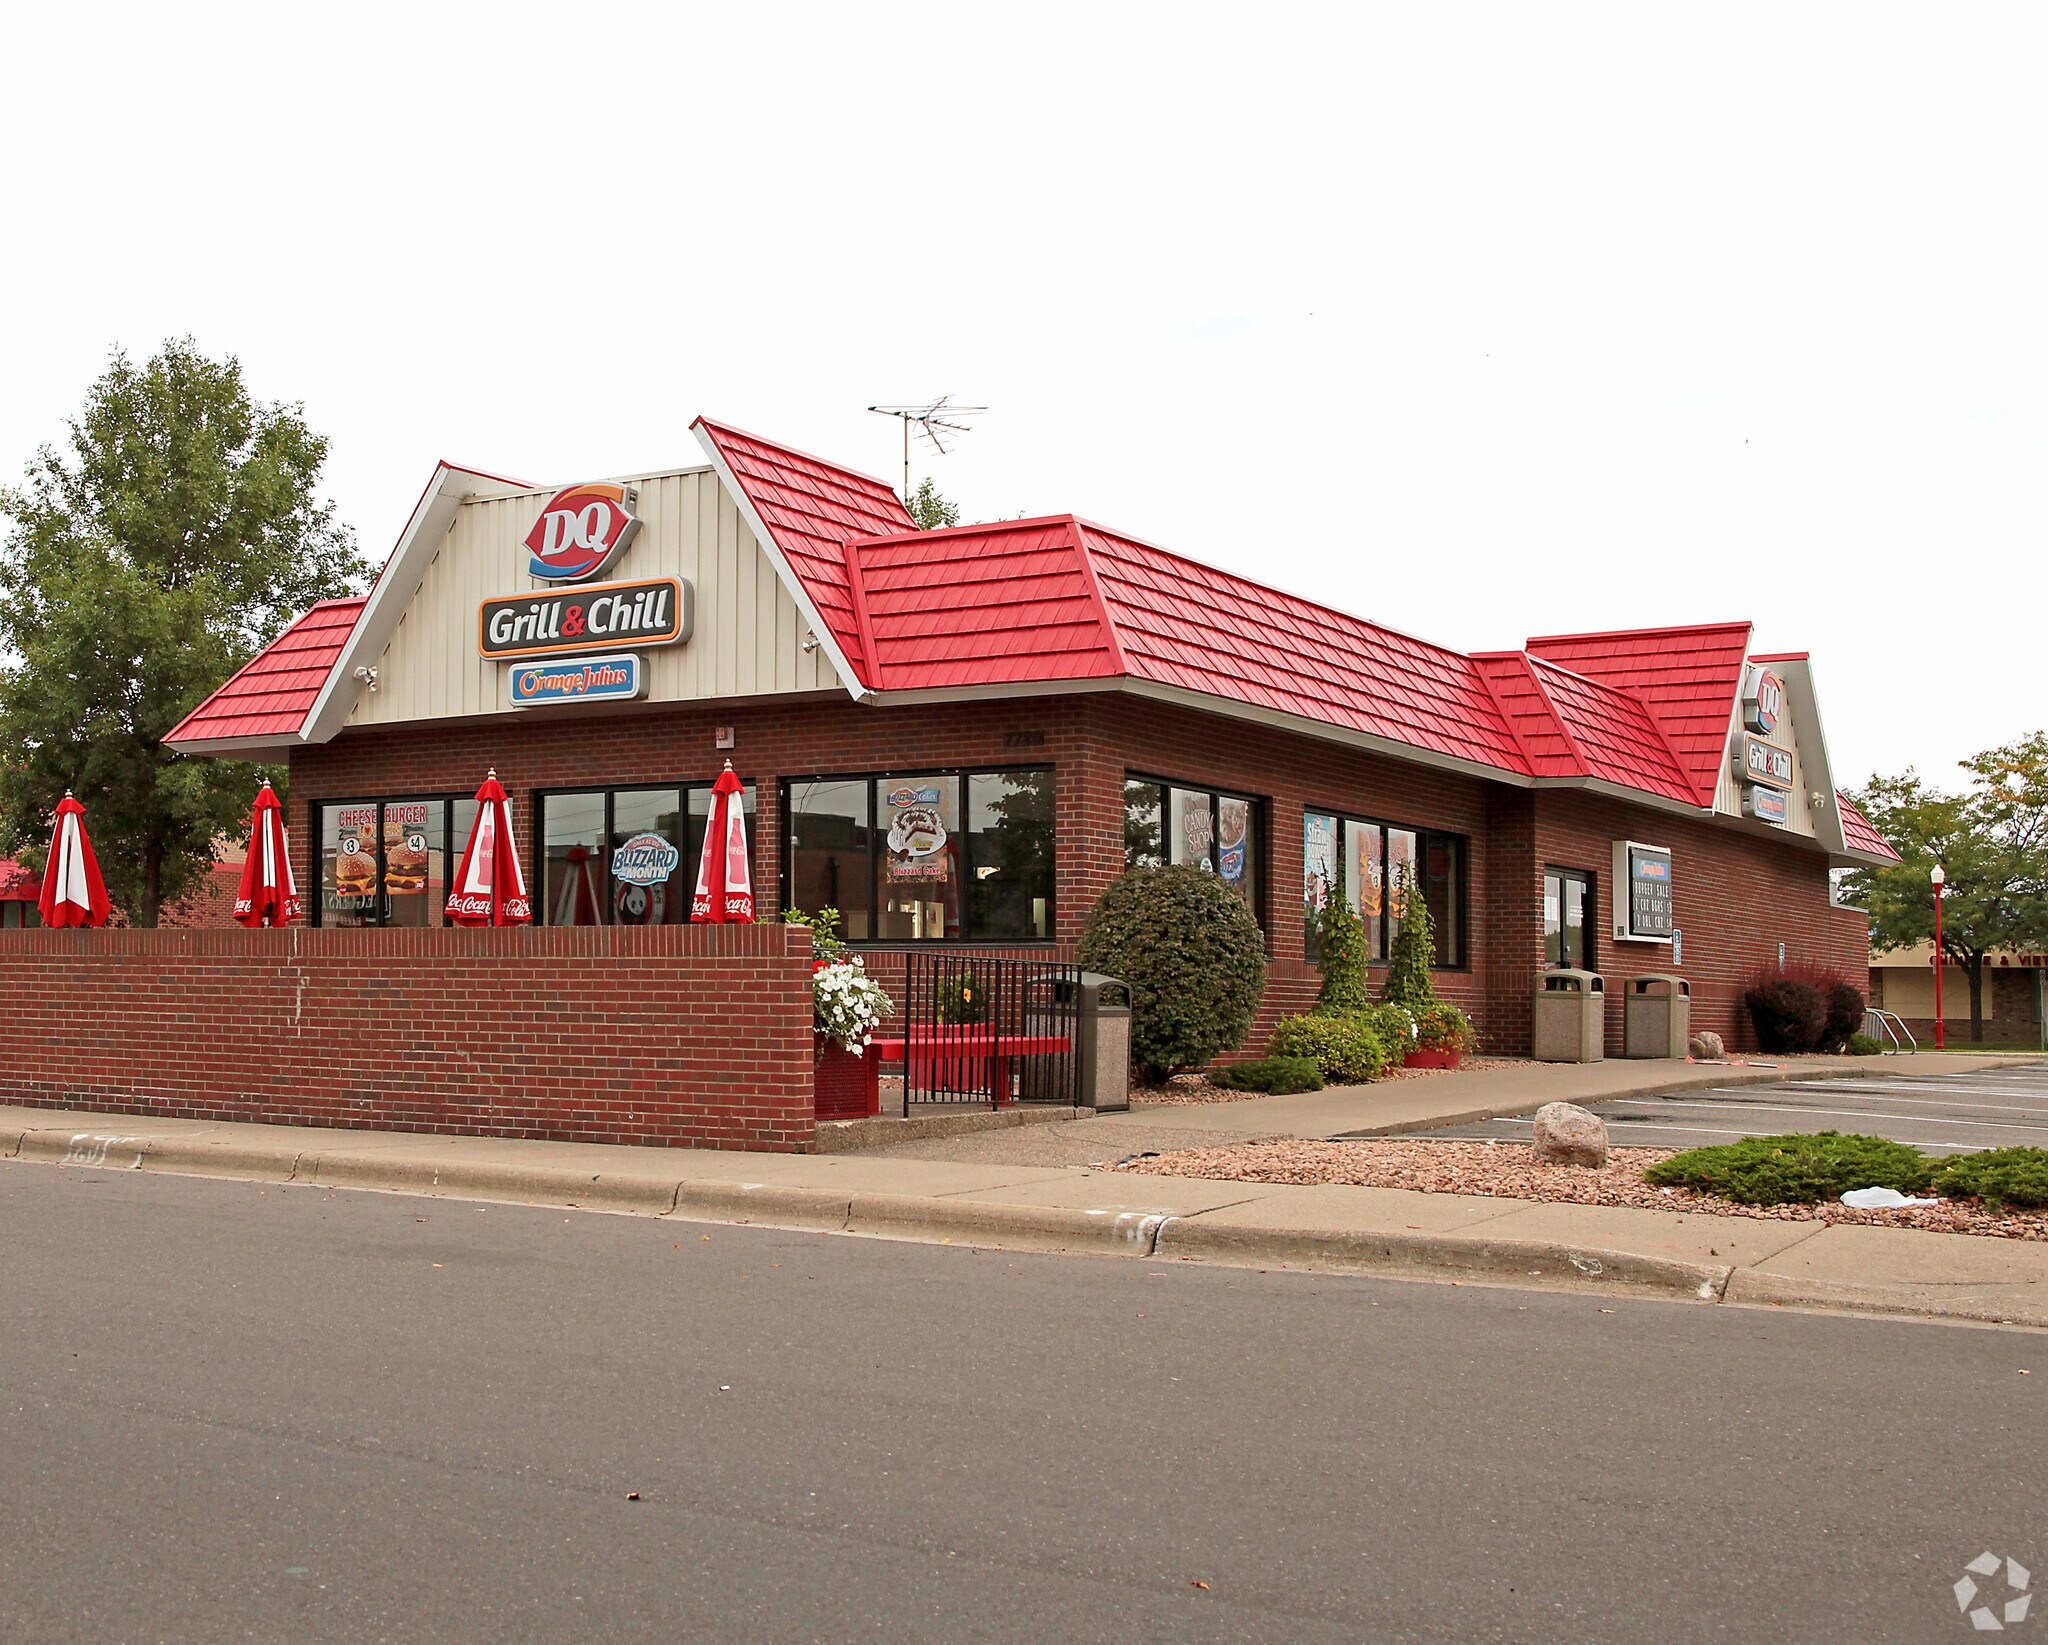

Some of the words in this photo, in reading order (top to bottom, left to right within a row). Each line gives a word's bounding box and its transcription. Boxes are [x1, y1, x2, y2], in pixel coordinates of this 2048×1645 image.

[540, 502, 611, 556] DQ
[1762, 683, 1779, 721] DQ
[339, 809, 377, 827] CHEESE
[384, 805, 427, 823] BURGER
[1184, 811, 1211, 833] CANDY
[346, 839, 355, 853] $3
[410, 837, 420, 850] $4
[1188, 831, 1210, 853] SHOP
[613, 849, 676, 871] BLIZZARD
[894, 866, 922, 876] Blizzard
[626, 867, 666, 879] MONTH
[1635, 882, 1653, 896] BURGER
[1656, 884, 1669, 898] SALE
